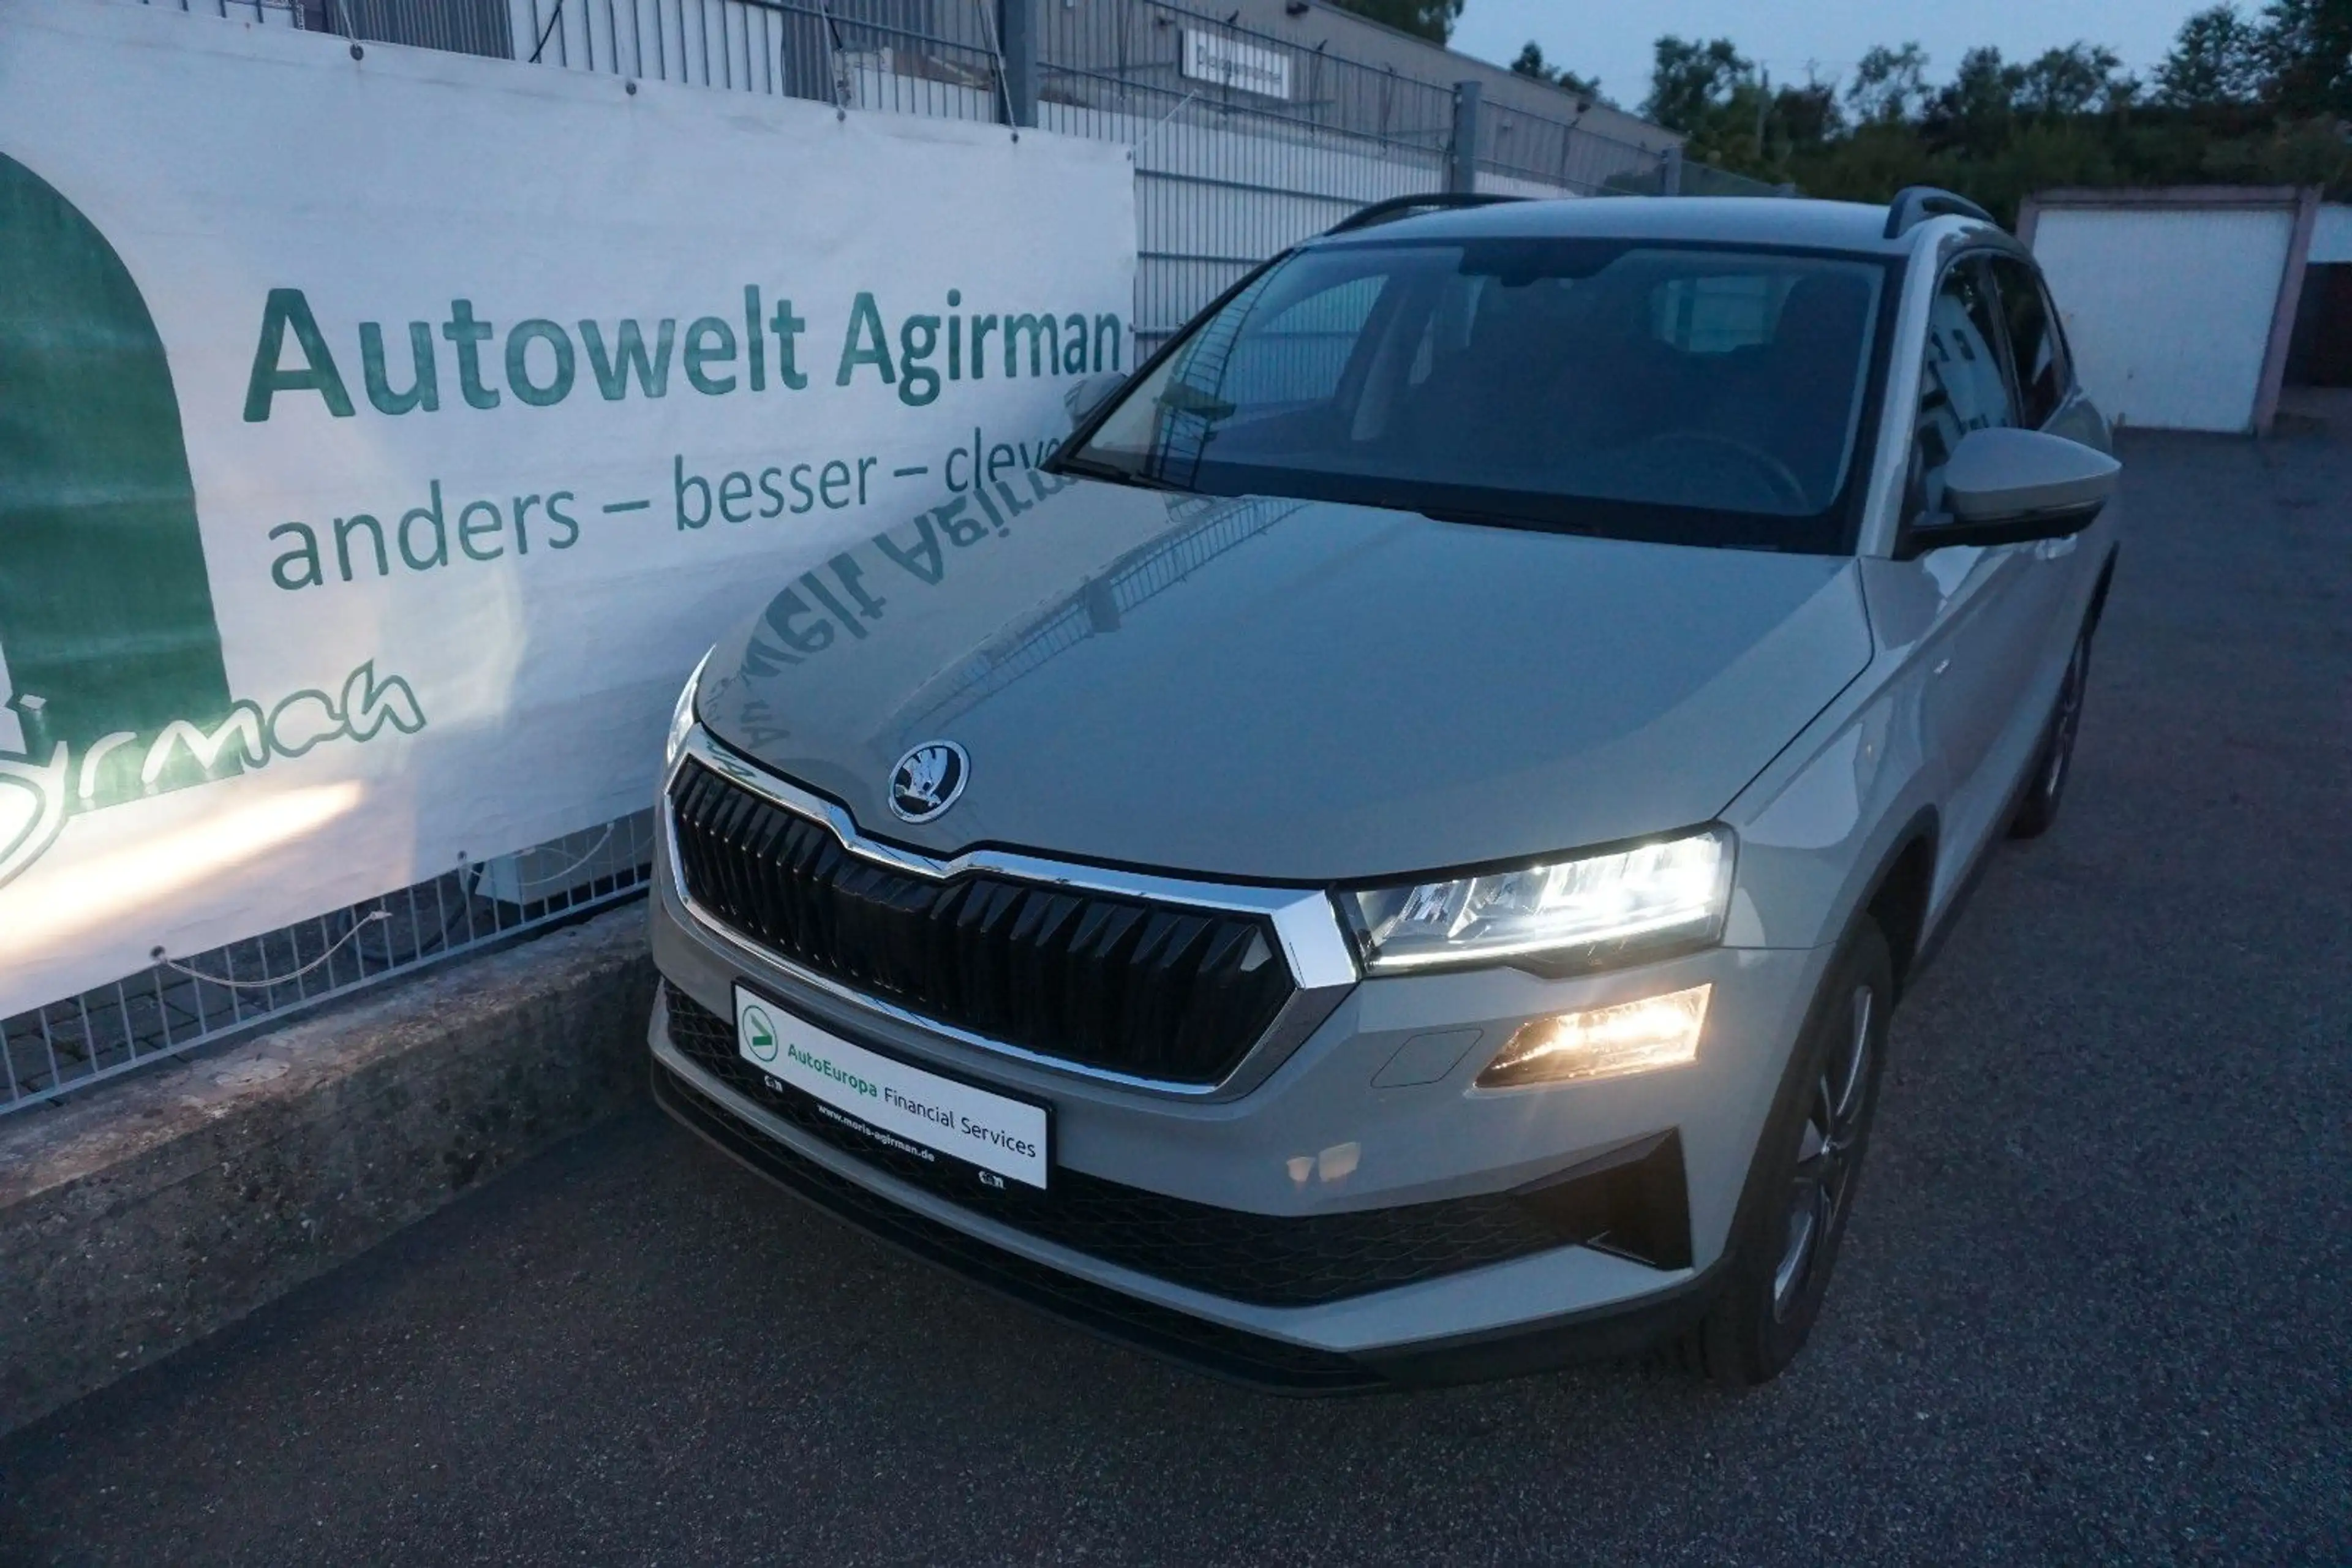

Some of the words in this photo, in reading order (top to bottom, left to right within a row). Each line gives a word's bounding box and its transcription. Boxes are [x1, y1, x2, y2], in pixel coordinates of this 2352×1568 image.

[243, 284, 808, 423] Autowelt
[835, 288, 1120, 407] Agirman
[268, 479, 580, 591] anders
[674, 454, 878, 531] besser
[788, 1043, 878, 1098] AutoEuropa
[884, 1087, 955, 1129] Financial
[961, 1117, 1036, 1158] Services
